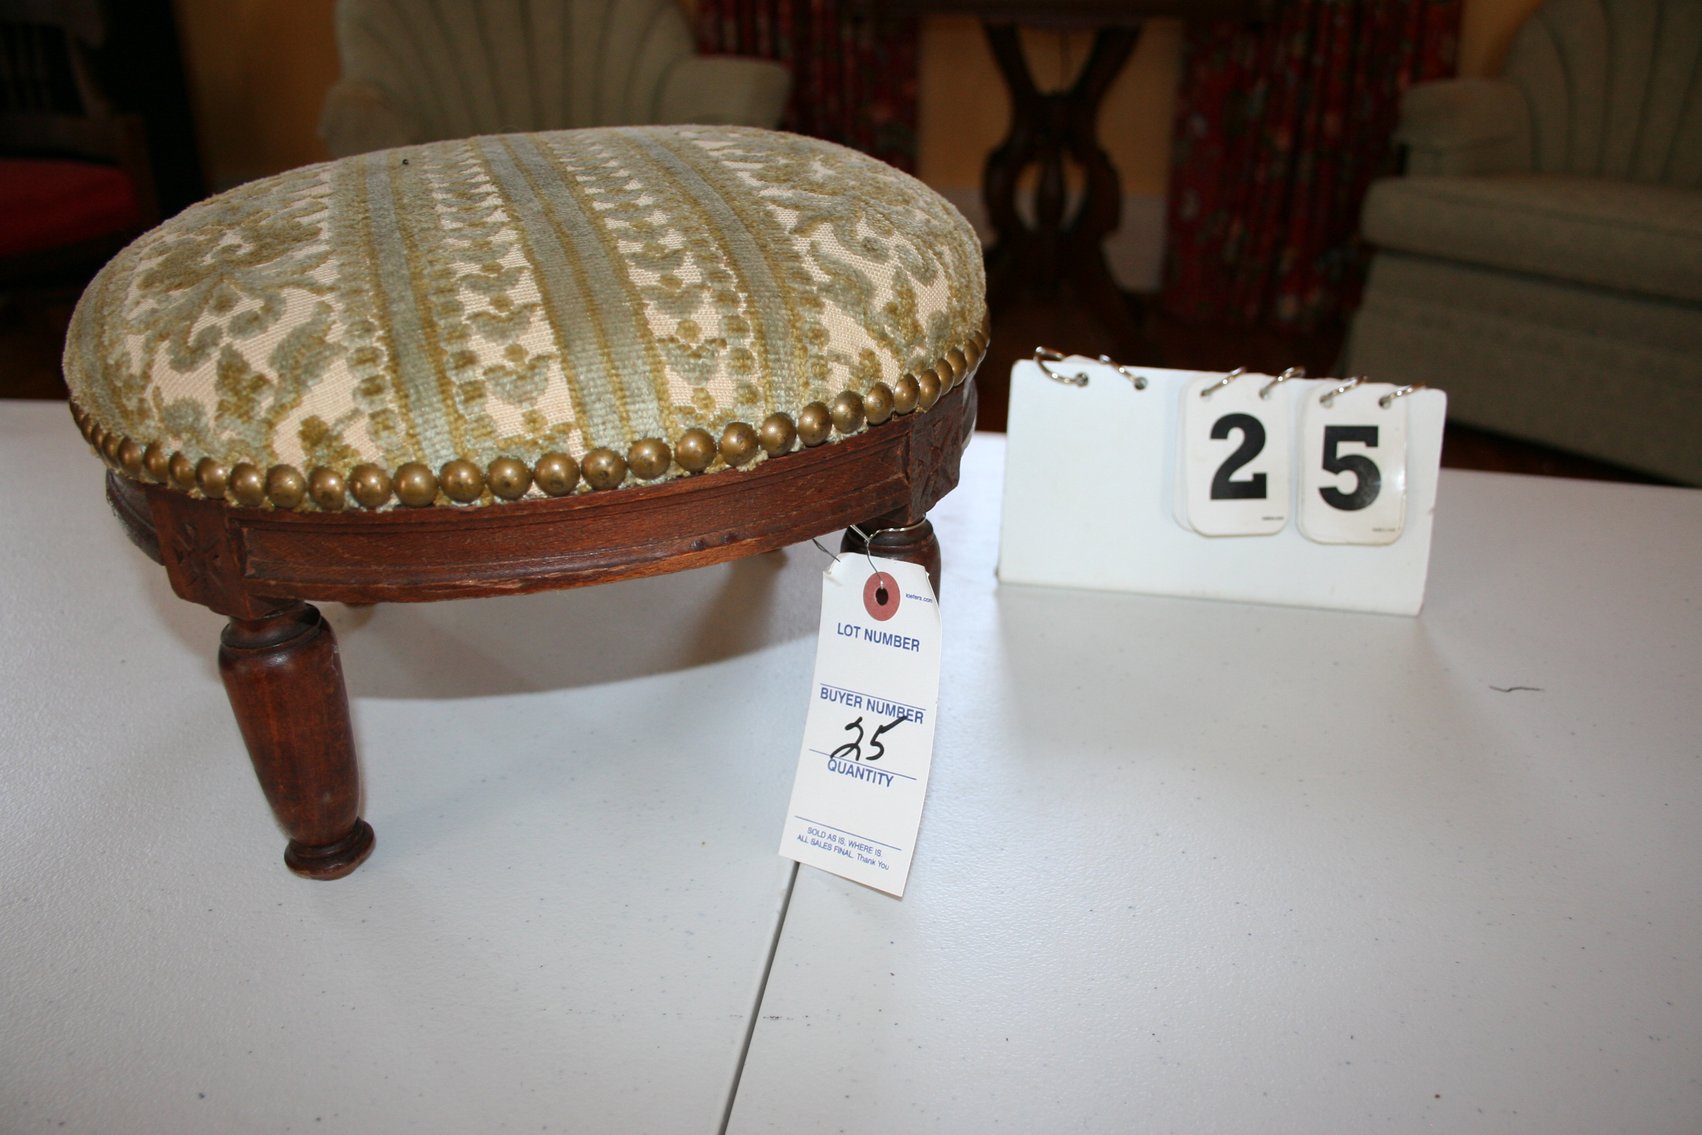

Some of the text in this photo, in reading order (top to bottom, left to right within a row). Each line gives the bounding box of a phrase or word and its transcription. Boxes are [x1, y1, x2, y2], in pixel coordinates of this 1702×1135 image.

[837, 622, 920, 652] LOT NUMBER
[820, 687, 924, 724] BUYER NUMBER
[829, 716, 908, 761] 25
[827, 758, 894, 787] QUANTITY
[797, 834, 809, 844] ALL
[810, 838, 832, 851] SALES
[856, 853, 876, 866] Thank
[877, 860, 890, 871] You
[807, 827, 826, 839] SOLD
[827, 833, 837, 842] AS
[848, 840, 873, 855] WHERE
